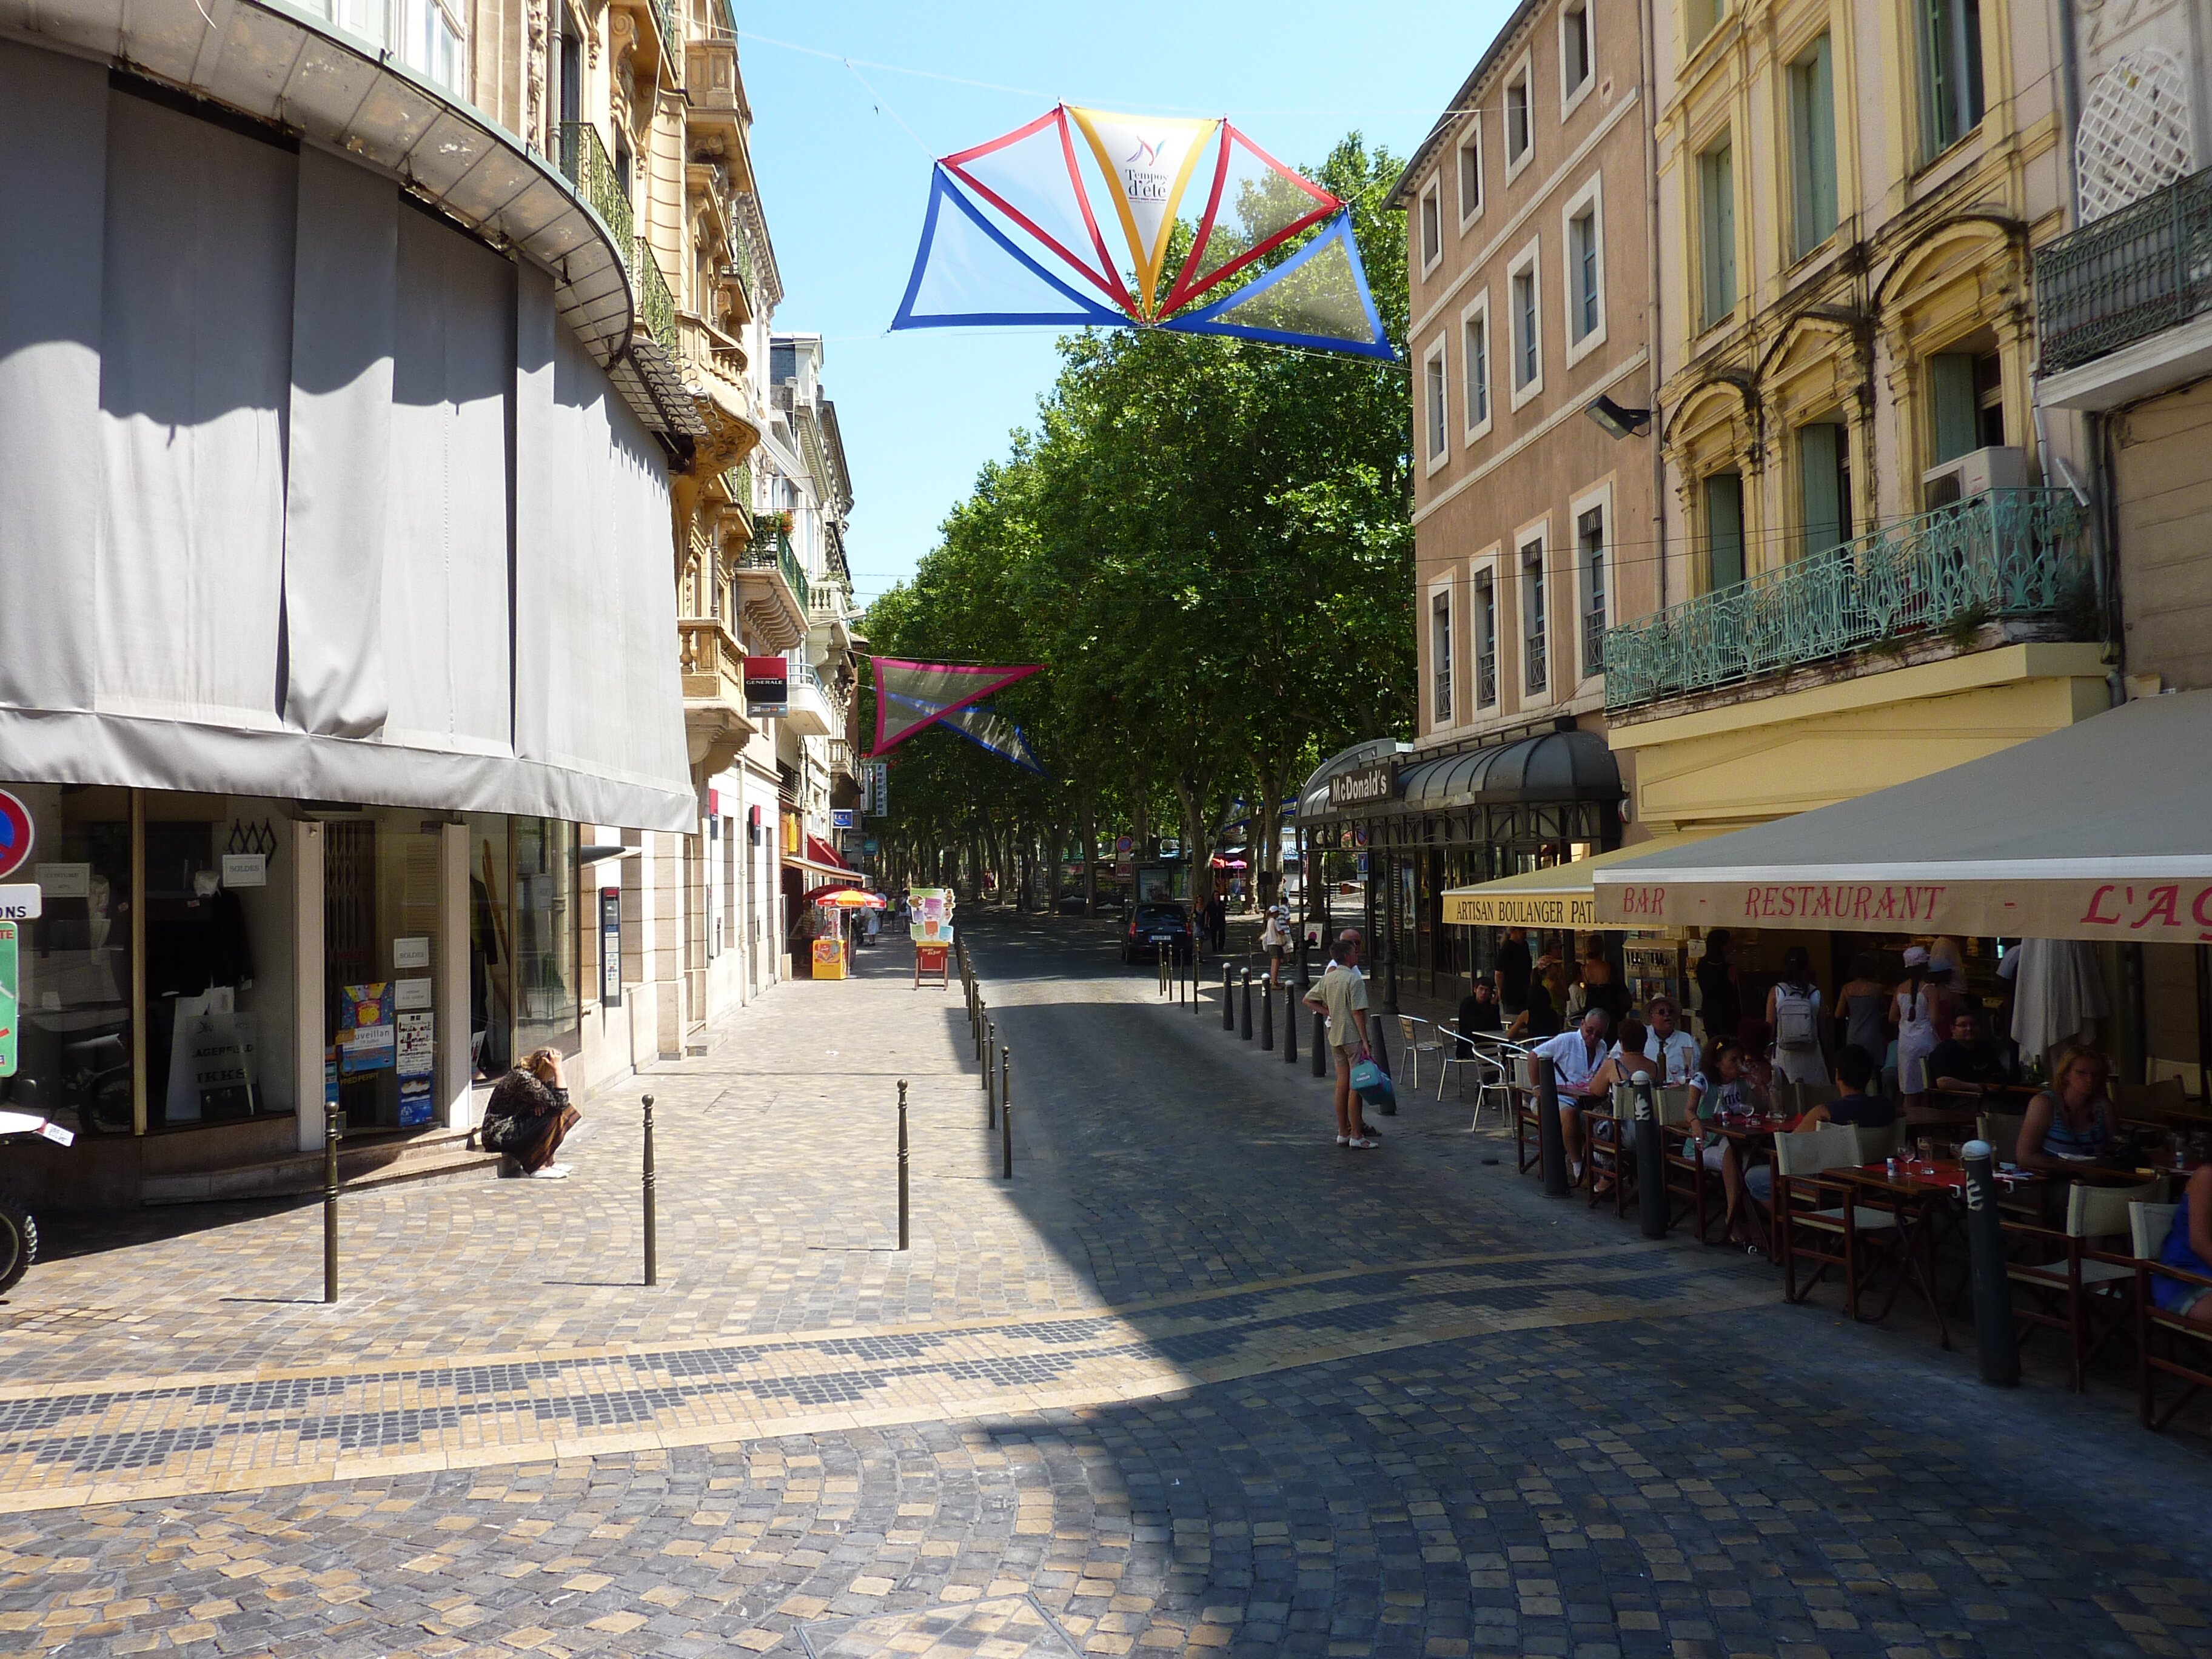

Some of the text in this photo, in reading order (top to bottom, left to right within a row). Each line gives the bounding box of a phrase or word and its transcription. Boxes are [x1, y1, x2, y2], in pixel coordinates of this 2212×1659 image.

[1125, 169, 1169, 183] Tempos
[1128, 180, 1166, 198] d'été
[1333, 769, 1387, 802] McDonald's
[1456, 901, 1494, 921] ARTISAN
[1499, 900, 1564, 923] BOULANGER
[1623, 887, 1666, 916] BAR
[1744, 886, 1946, 921] RESTAURANT
[340, 1071, 380, 1085] FRED PERRY
